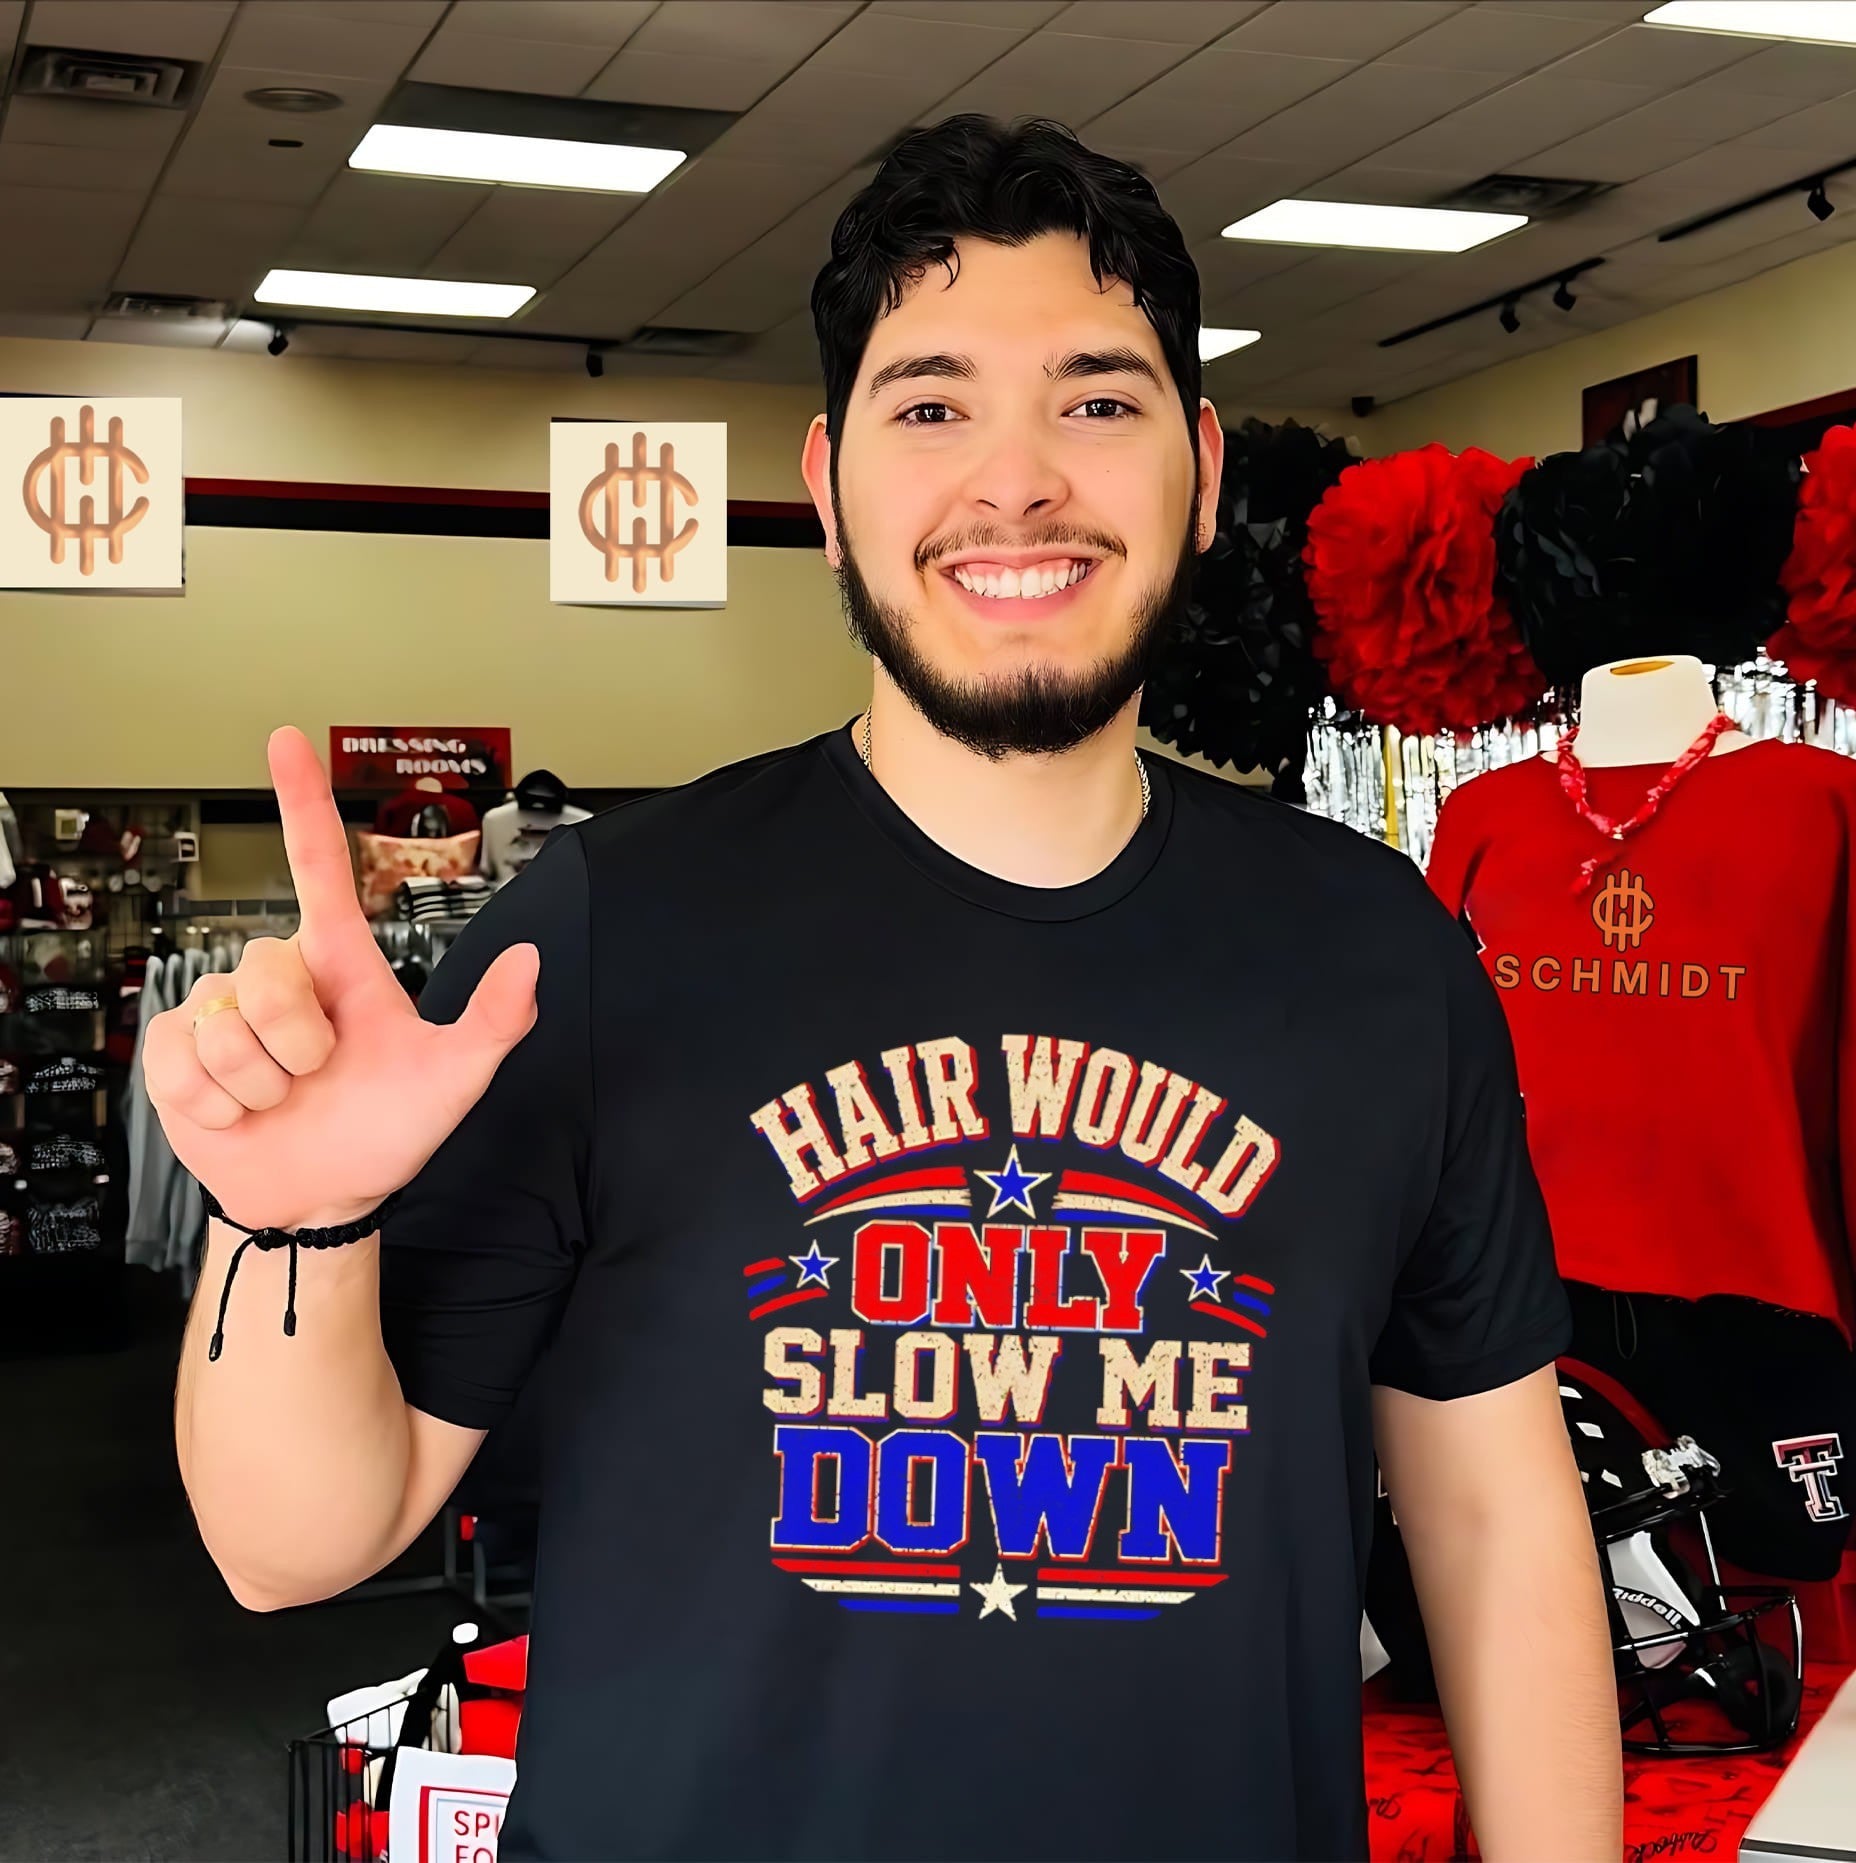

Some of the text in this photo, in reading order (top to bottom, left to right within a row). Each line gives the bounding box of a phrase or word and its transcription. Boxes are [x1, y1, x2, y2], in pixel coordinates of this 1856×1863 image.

[342, 737, 467, 754] DRESSING
[396, 758, 487, 775] ROOMS
[1494, 953, 1746, 1000] SCHMIDT
[749, 1034, 1282, 1219] HAIR WOULD
[851, 1220, 1167, 1333] ONLY
[762, 1326, 1252, 1433] SLOW ME
[770, 1424, 1233, 1566] DOWN
[453, 1810, 500, 1838] SPI
